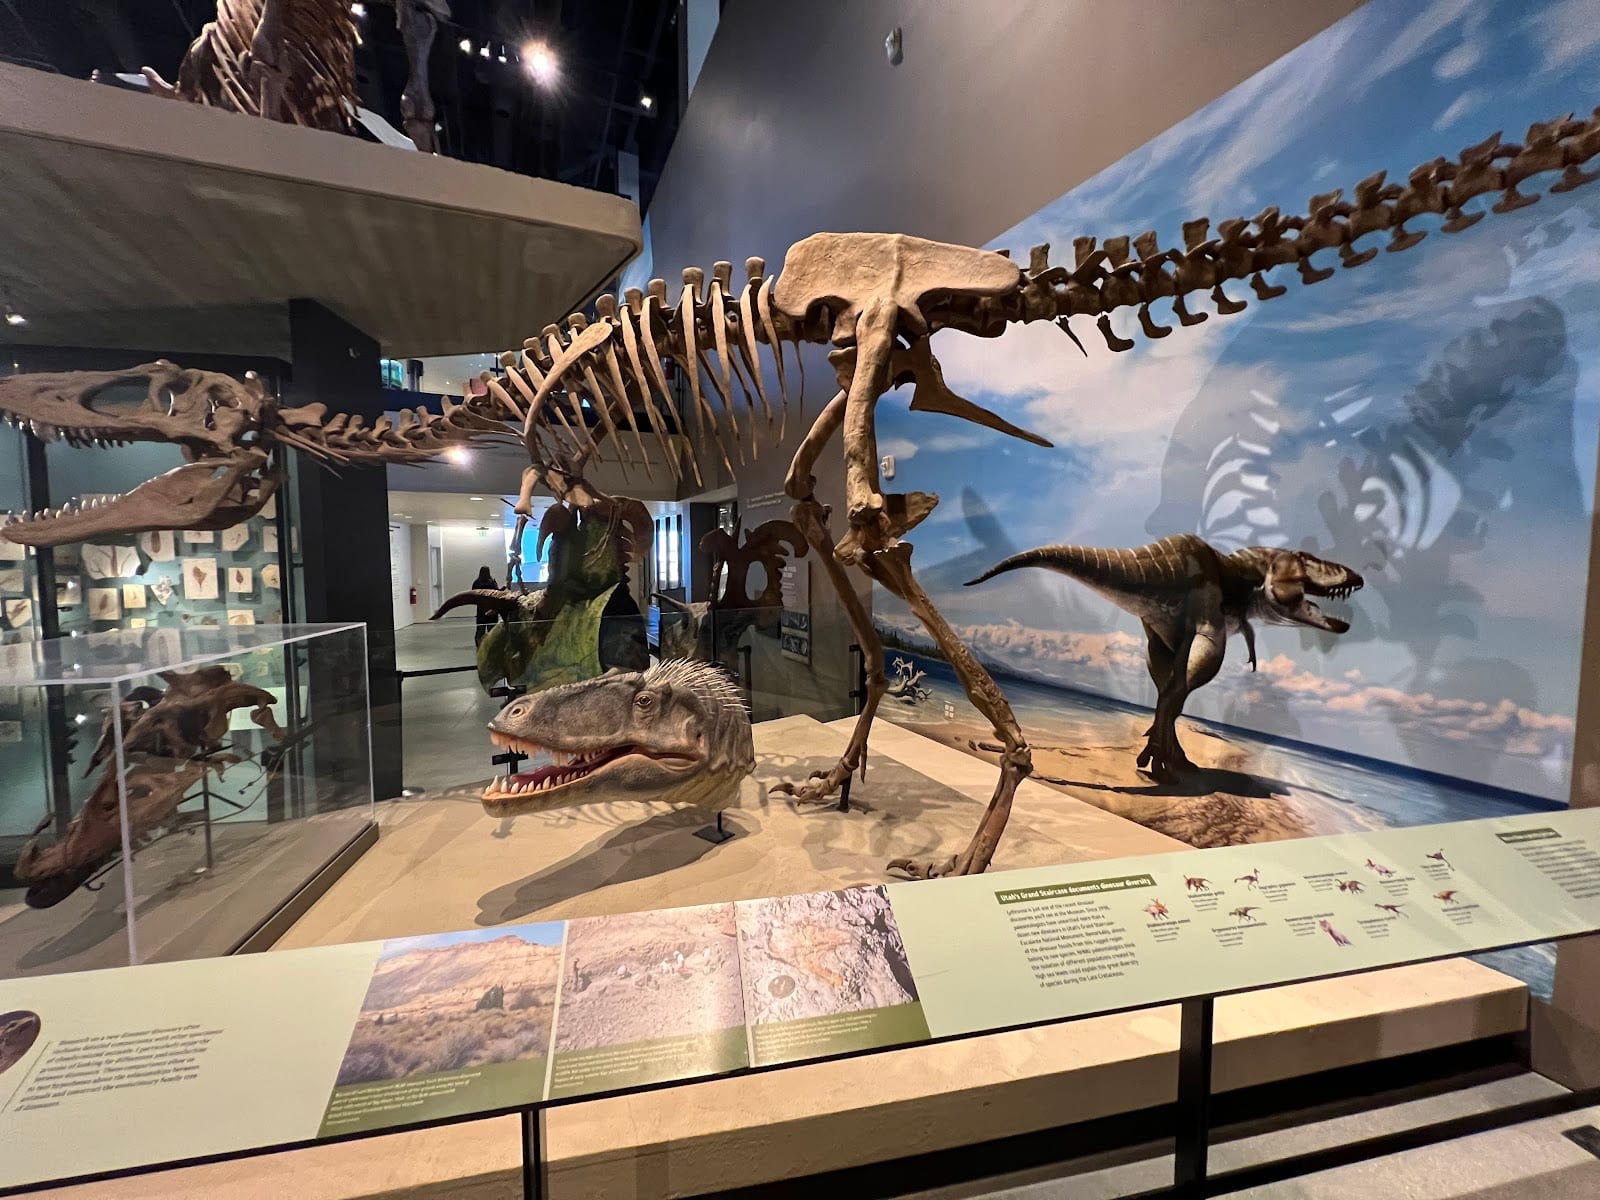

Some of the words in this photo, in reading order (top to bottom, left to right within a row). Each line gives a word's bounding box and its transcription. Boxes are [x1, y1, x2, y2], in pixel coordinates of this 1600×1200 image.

[1000, 893, 1020, 902] Utah's
[1020, 890, 1040, 898] Grand
[1039, 888, 1068, 896] Staircase
[1068, 884, 1100, 894] documents
[1100, 881, 1124, 890] dinosaur
[1126, 878, 1151, 886] diversity
